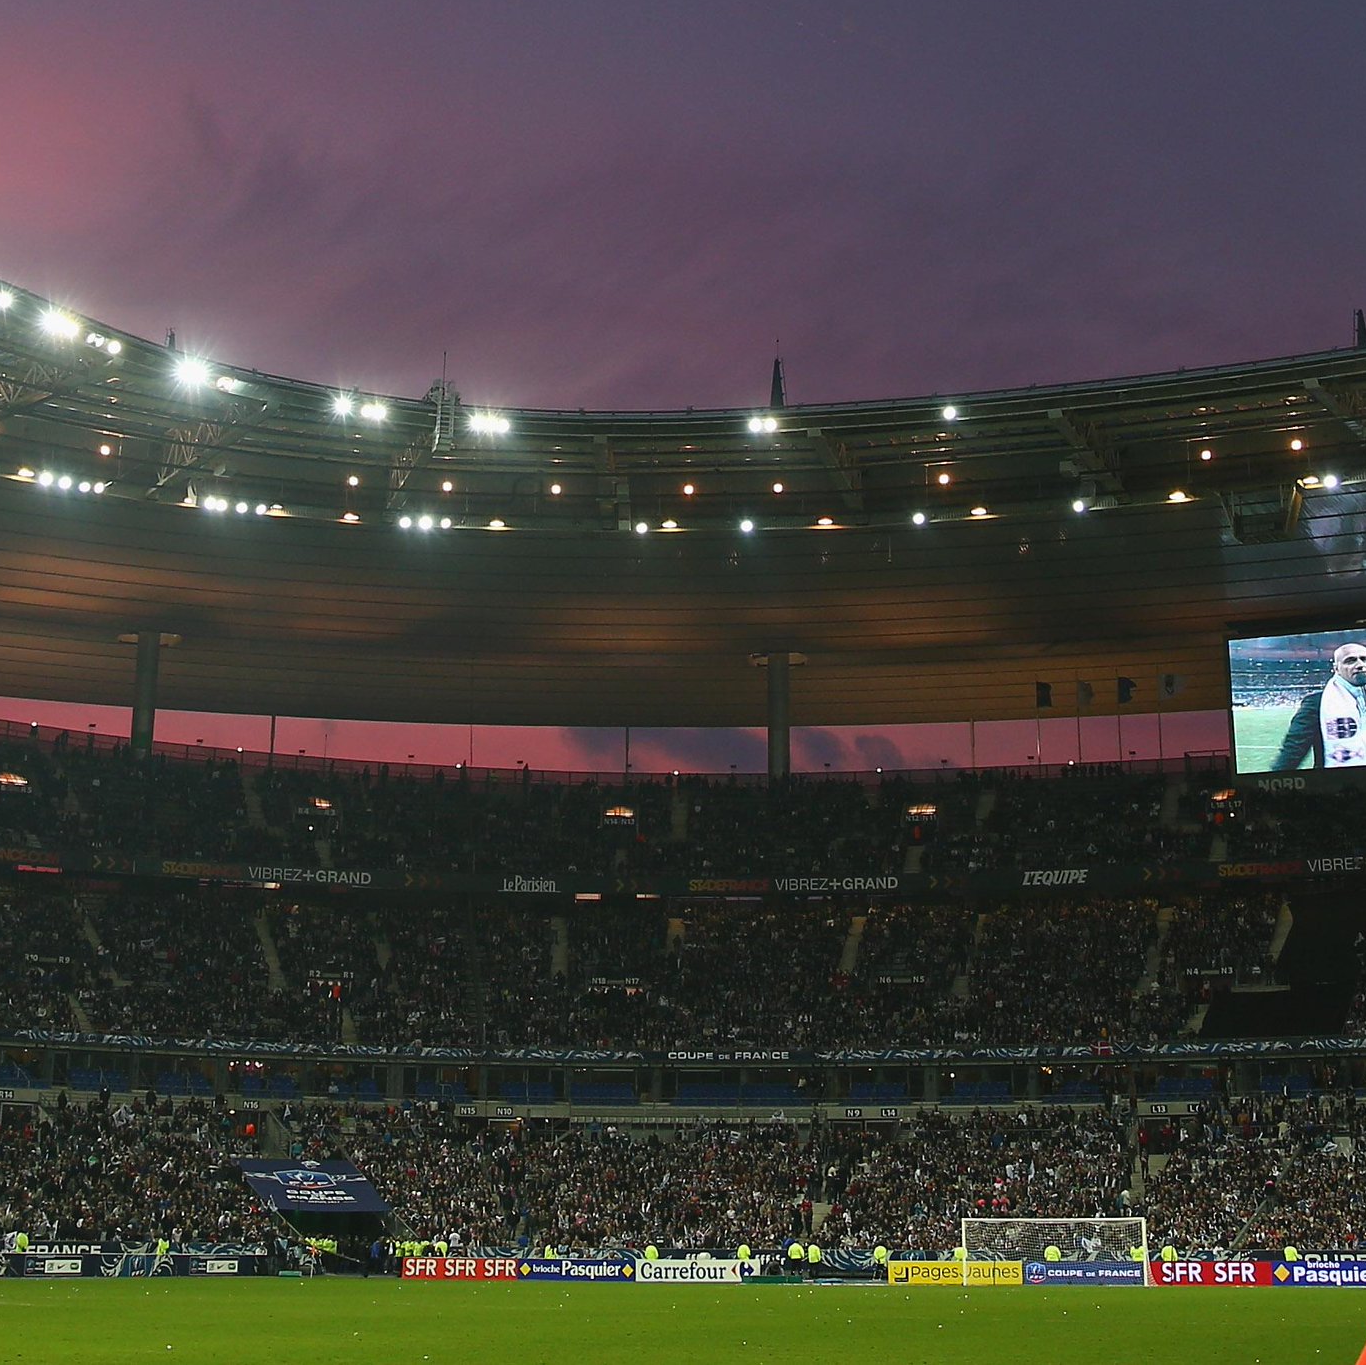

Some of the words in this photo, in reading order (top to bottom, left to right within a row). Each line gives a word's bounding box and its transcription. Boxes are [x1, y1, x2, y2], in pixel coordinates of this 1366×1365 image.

[1258, 777, 1305, 792] NORD
[668, 1051, 714, 1060] COUPE
[735, 1051, 790, 1060] FRANCE
[243, 1101, 259, 1109] N16
[1153, 1105, 1166, 1113] L13
[461, 1106, 476, 1115] N15
[497, 1107, 512, 1116] N10
[847, 1109, 860, 1117] N9
[882, 1108, 896, 1117] L14
[405, 1259, 436, 1276] SFR
[445, 1259, 476, 1276] SFR
[484, 1259, 516, 1277] SFR
[1307, 1261, 1340, 1269] brioche
[532, 1263, 561, 1274] brioche
[561, 1260, 621, 1280] Pasquier
[641, 1262, 726, 1280] Carrefour
[1048, 1269, 1083, 1277] COUPE
[1099, 1269, 1141, 1277] FRANCE
[1162, 1262, 1203, 1282] SFR
[1214, 1262, 1256, 1282] SFR
